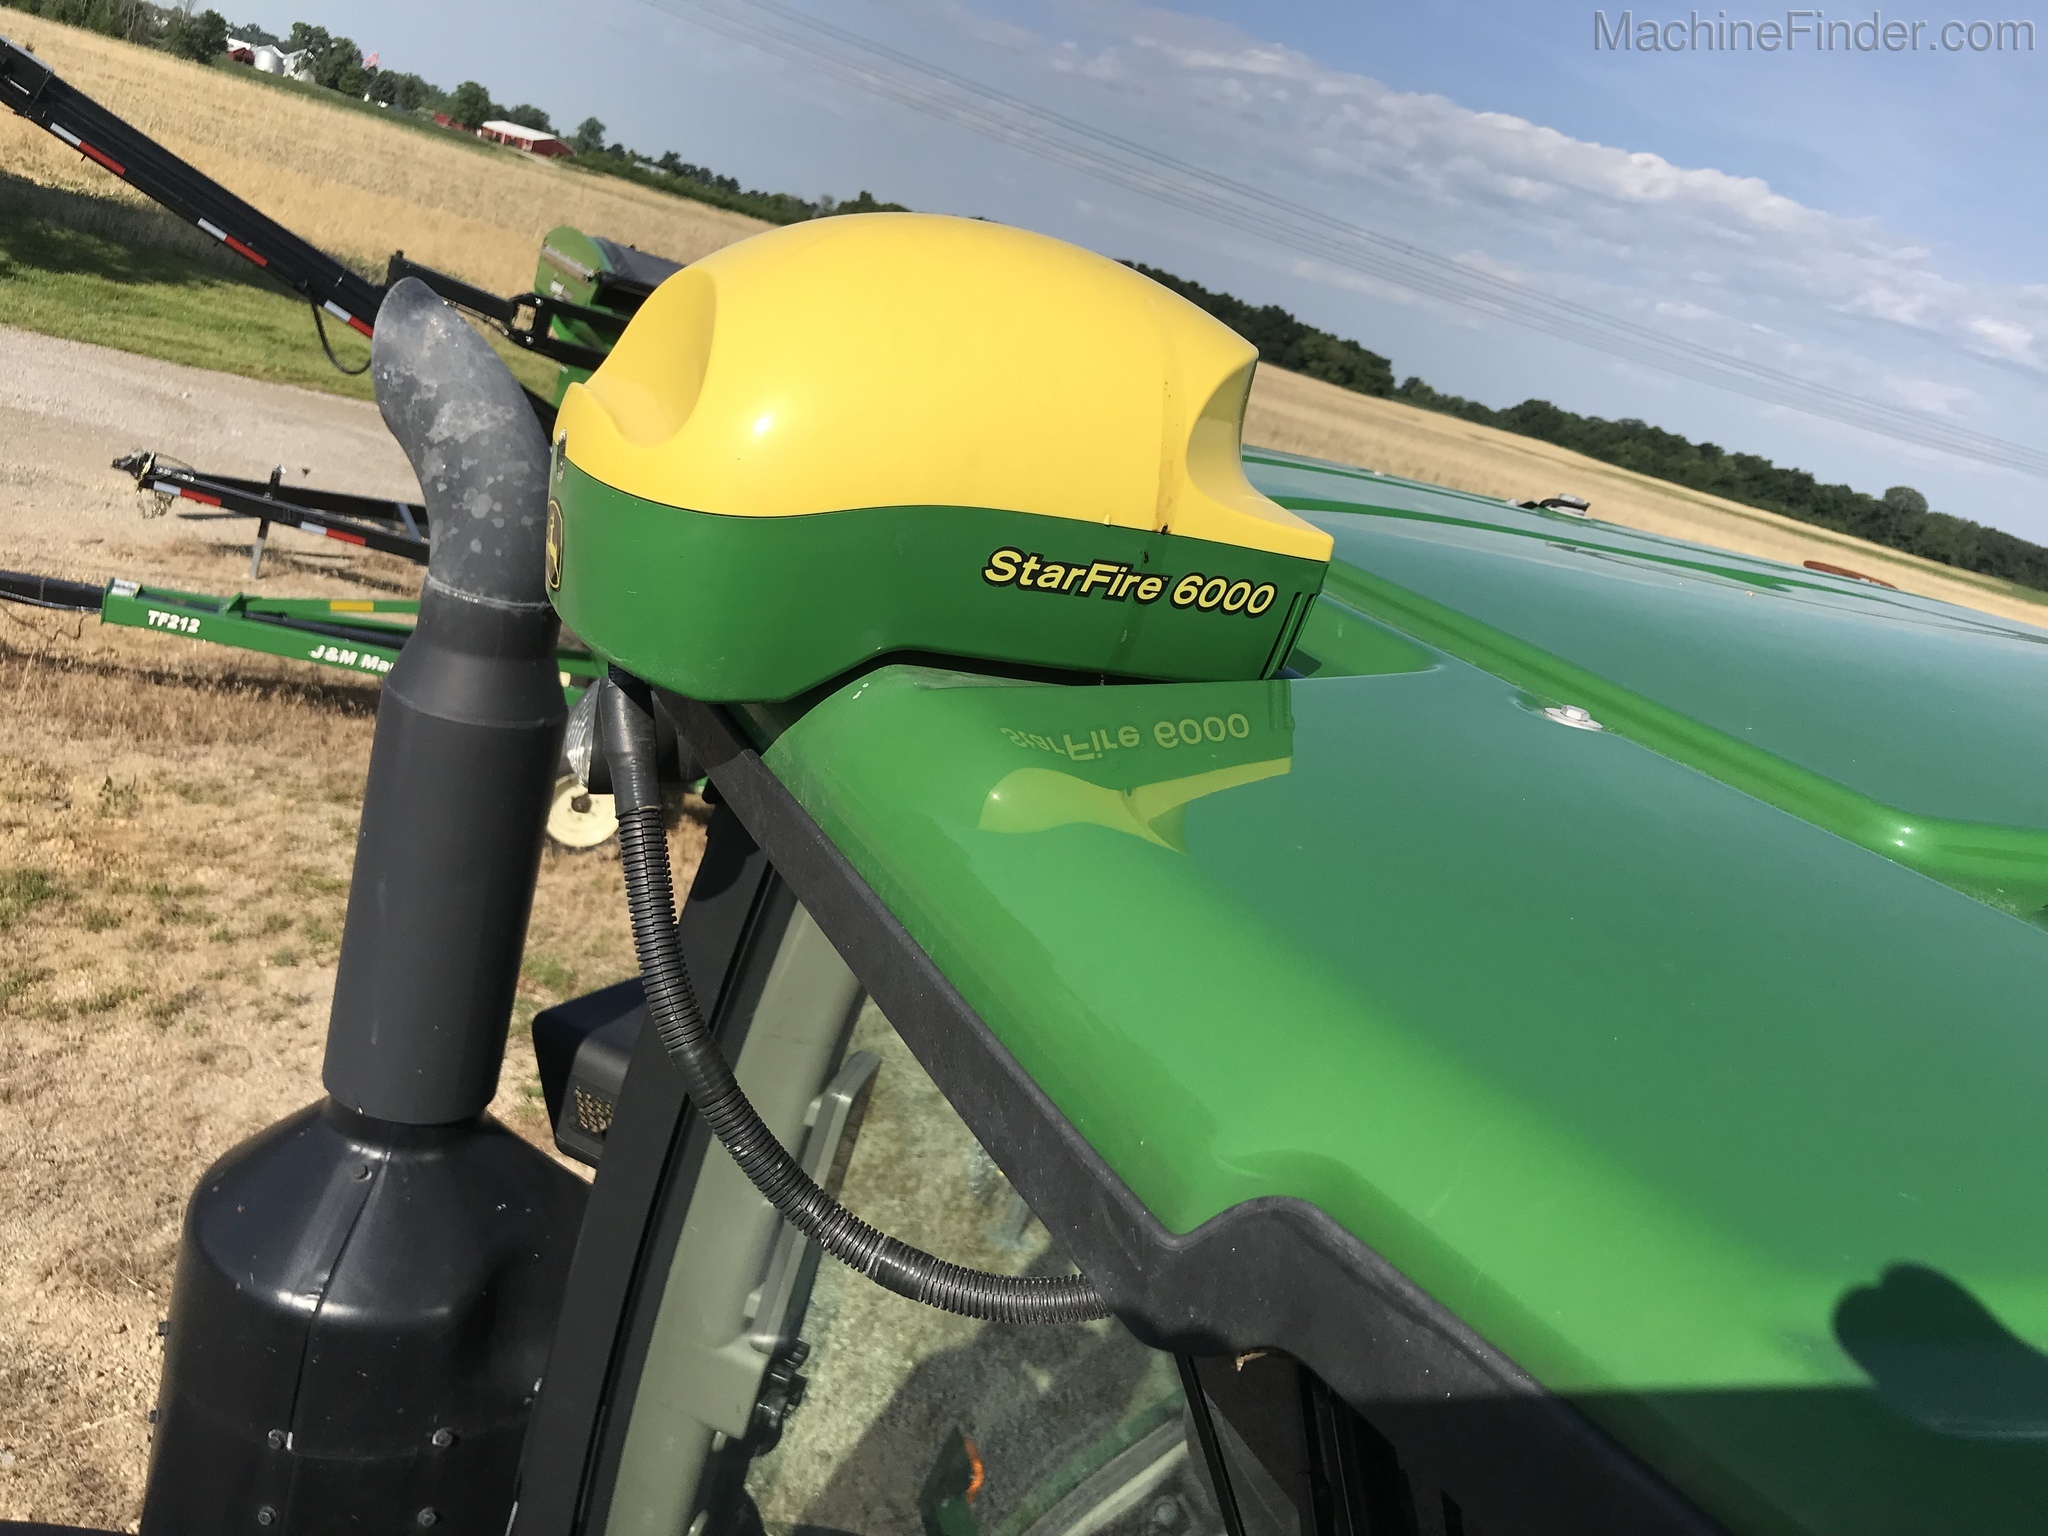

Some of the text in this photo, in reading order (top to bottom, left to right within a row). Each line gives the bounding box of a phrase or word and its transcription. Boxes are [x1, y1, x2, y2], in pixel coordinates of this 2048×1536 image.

[1172, 575, 1276, 615] 6000
[147, 609, 201, 634] TF212
[308, 644, 395, 673] J&M Ma
